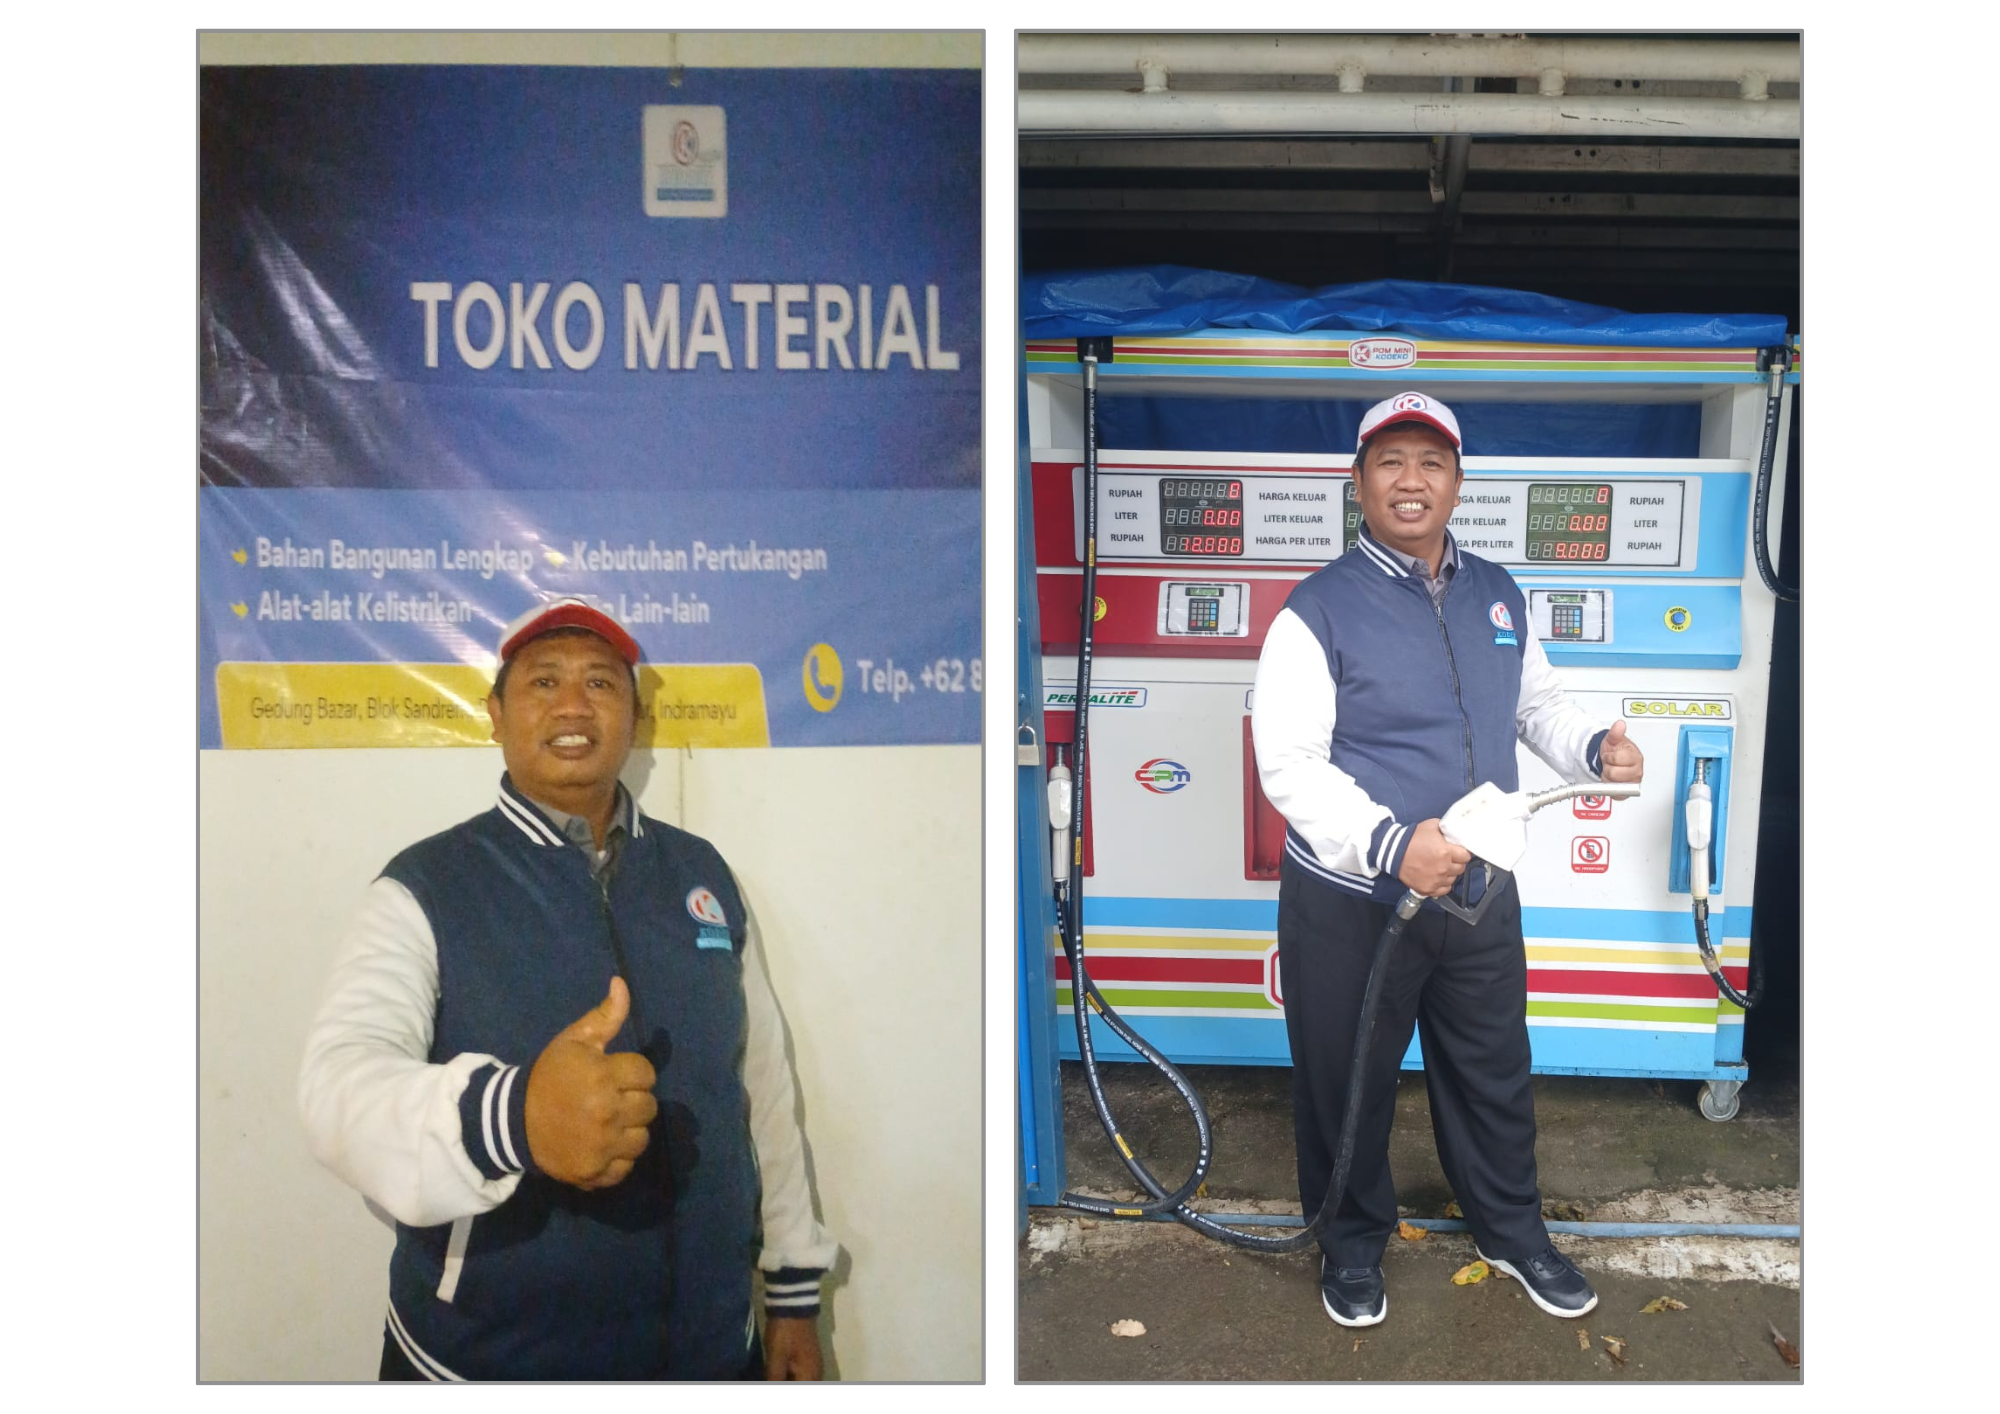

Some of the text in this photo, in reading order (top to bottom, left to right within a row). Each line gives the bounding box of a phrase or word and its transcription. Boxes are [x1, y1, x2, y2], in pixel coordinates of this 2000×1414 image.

[410, 281, 960, 371] TOKO MATERIAL
[1109, 489, 1142, 498] RUPIAH
[1258, 492, 1327, 502] HARGA KELUAR
[1476, 496, 1511, 504] KELUAR
[1630, 497, 1664, 505] RUPIAH
[1114, 512, 1138, 520] LITER
[1264, 515, 1323, 524] LITER KELUAR
[1447, 518, 1506, 526] LITER KELUAR
[1634, 520, 1658, 528] LITER
[1110, 534, 1144, 542] RUPIAH
[1256, 536, 1331, 546] HARGA PER LITER
[1472, 540, 1488, 548] PER
[1491, 540, 1514, 548] LITER
[1628, 542, 1662, 550] RUPIAH
[256, 536, 534, 580] Bahan Bangunan Lengkap
[572, 538, 828, 580] Kebutuhan Pertukangan
[256, 588, 472, 622] Alat-alat Kelistrikan
[619, 592, 710, 624] Lain-lain
[856, 659, 982, 703] Telp. +62 8
[1046, 694, 1136, 704] PERALITE
[251, 696, 313, 726] Gedung
[318, 697, 363, 721] Bazar,
[367, 697, 400, 720] Blok
[404, 697, 474, 720] Sandre
[658, 701, 737, 724] Indramayu
[1630, 701, 1725, 716] SOLAR
